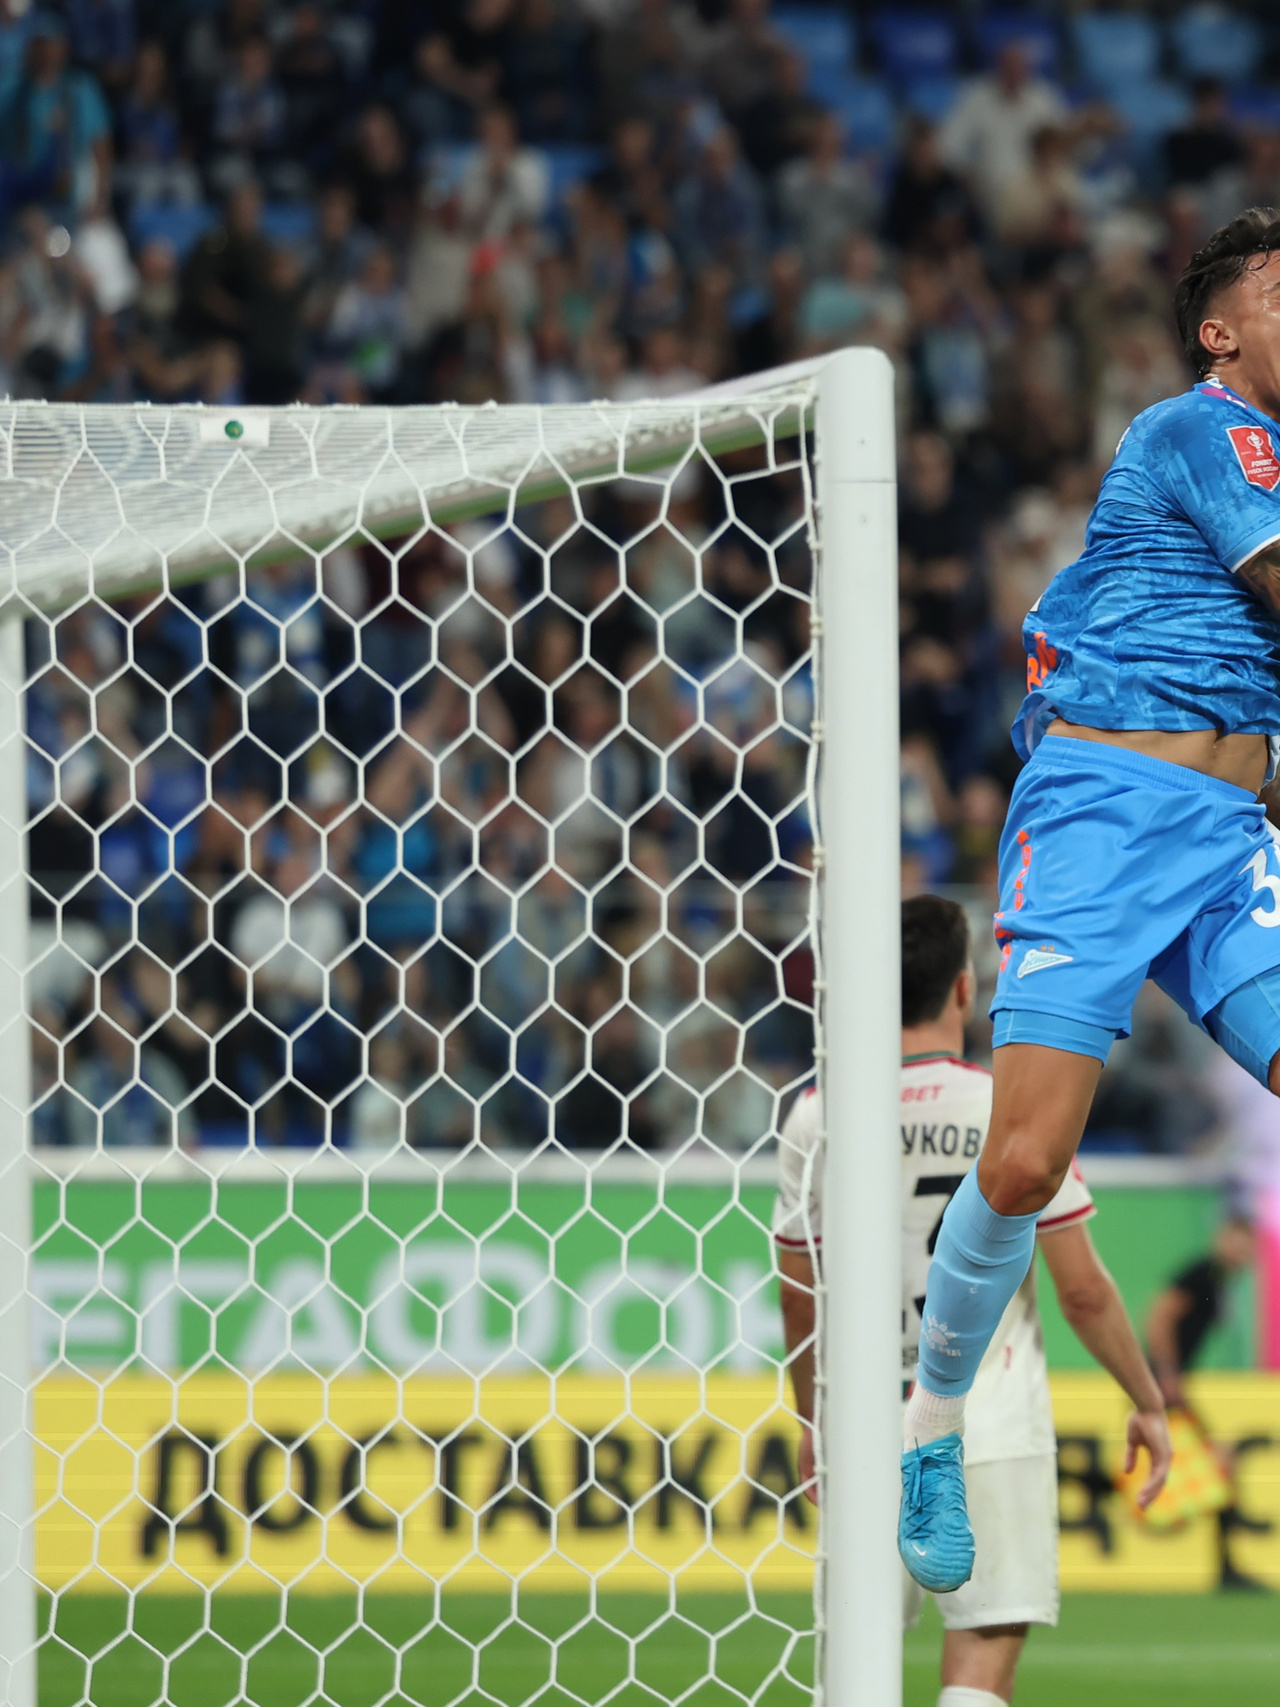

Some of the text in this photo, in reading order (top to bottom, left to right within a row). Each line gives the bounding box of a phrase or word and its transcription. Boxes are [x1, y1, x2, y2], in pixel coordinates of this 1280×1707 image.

[901, 1123, 982, 1158] УКОВ
[33, 1240, 785, 1370] ЕГАФОН
[136, 1430, 812, 1560] ДОСТАВКА
